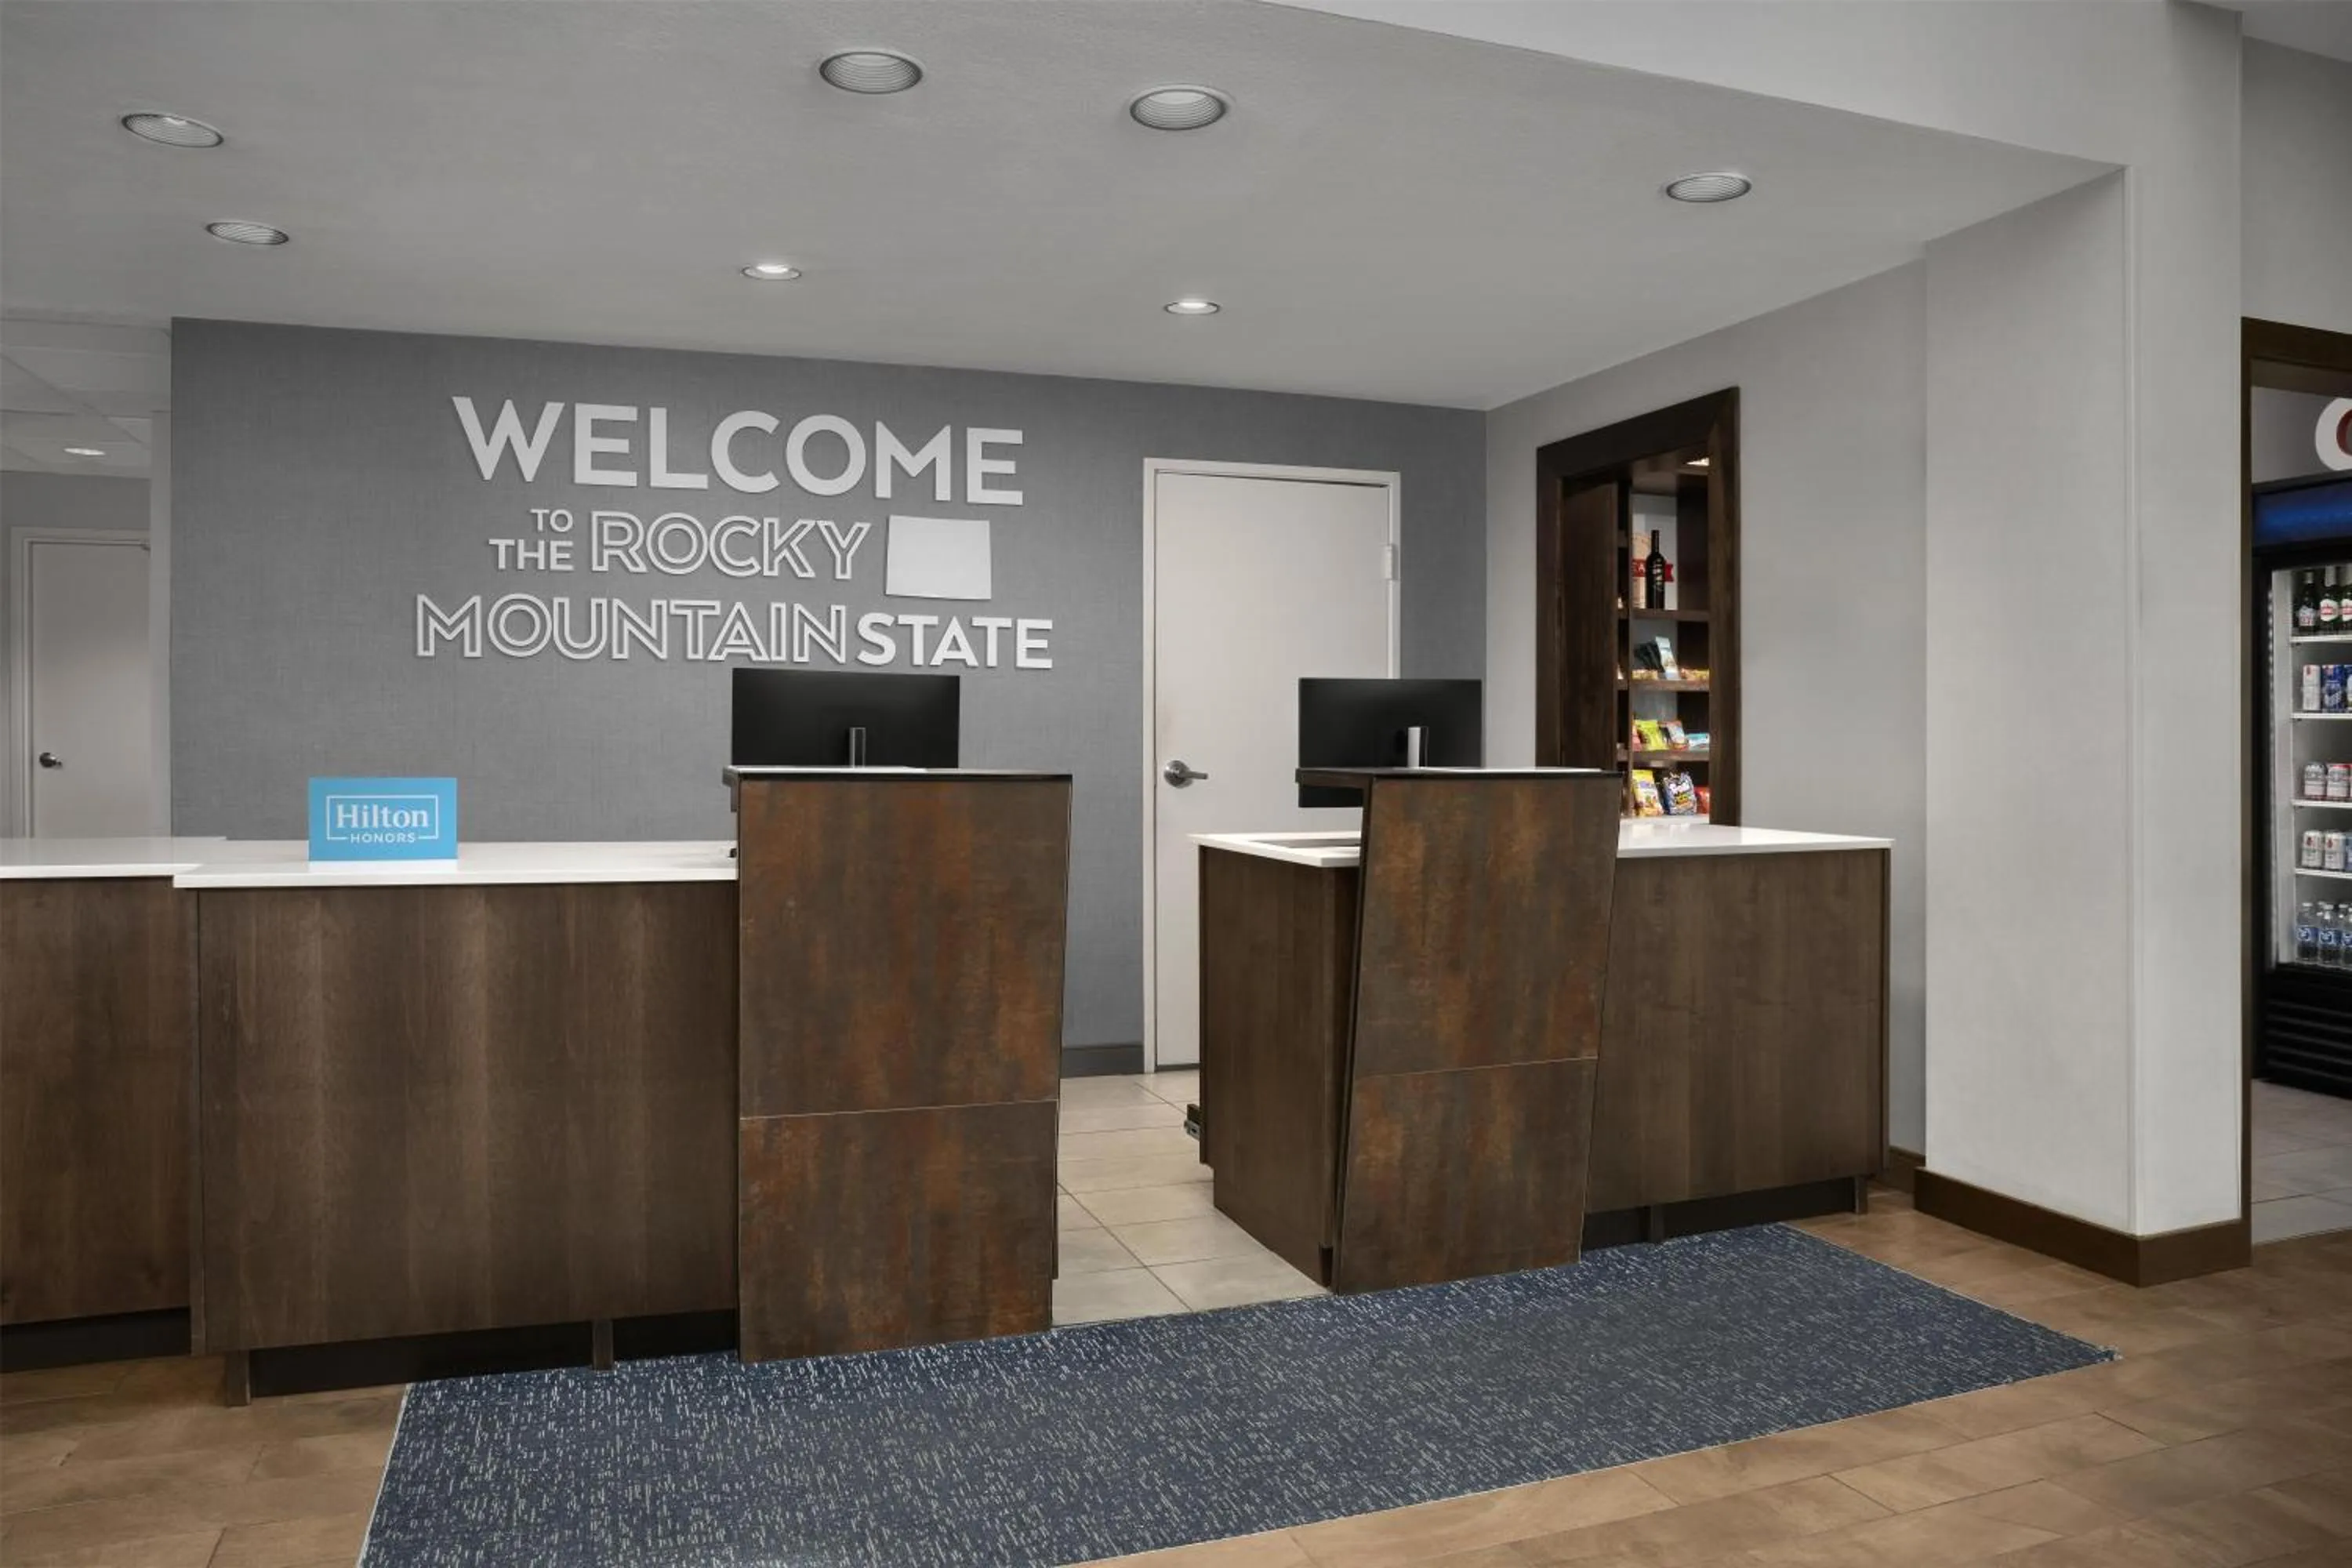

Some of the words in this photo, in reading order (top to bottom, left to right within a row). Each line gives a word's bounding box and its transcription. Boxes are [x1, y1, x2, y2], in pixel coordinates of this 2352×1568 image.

[452, 396, 1023, 505] WELCOME
[531, 509, 573, 533] TO
[489, 539, 574, 571] THE
[590, 511, 871, 579] ROCKY
[416, 593, 847, 664] MOUNTAIN
[856, 613, 1053, 669] STATE
[336, 804, 430, 828] Hilton
[350, 833, 416, 843] HONORS
